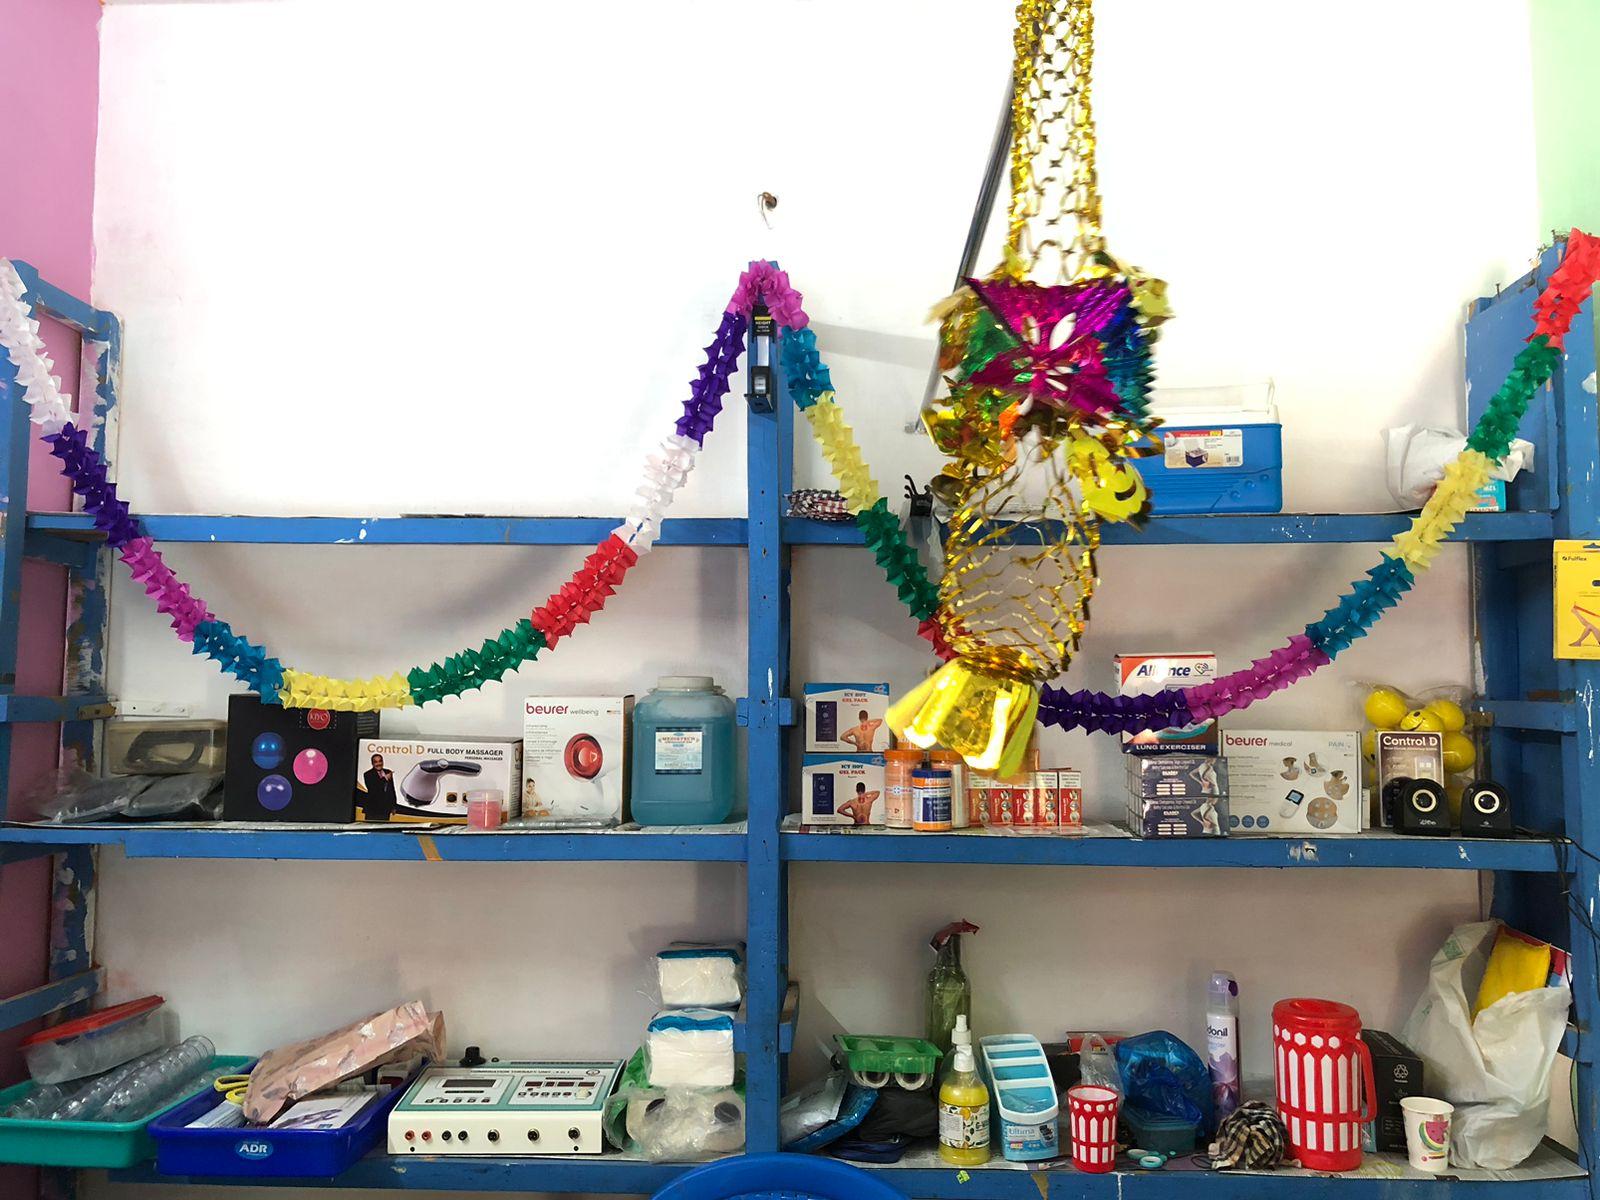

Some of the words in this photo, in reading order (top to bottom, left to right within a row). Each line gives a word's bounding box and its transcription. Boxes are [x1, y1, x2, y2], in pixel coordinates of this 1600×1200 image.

[526, 703, 569, 714] beurer
[1225, 734, 1268, 747] beurer
[1383, 736, 1426, 746] Control
[1429, 737, 1438, 746] D
[367, 743, 413, 754] Control
[416, 746, 425, 755] D
[239, 1144, 268, 1153] ADR
